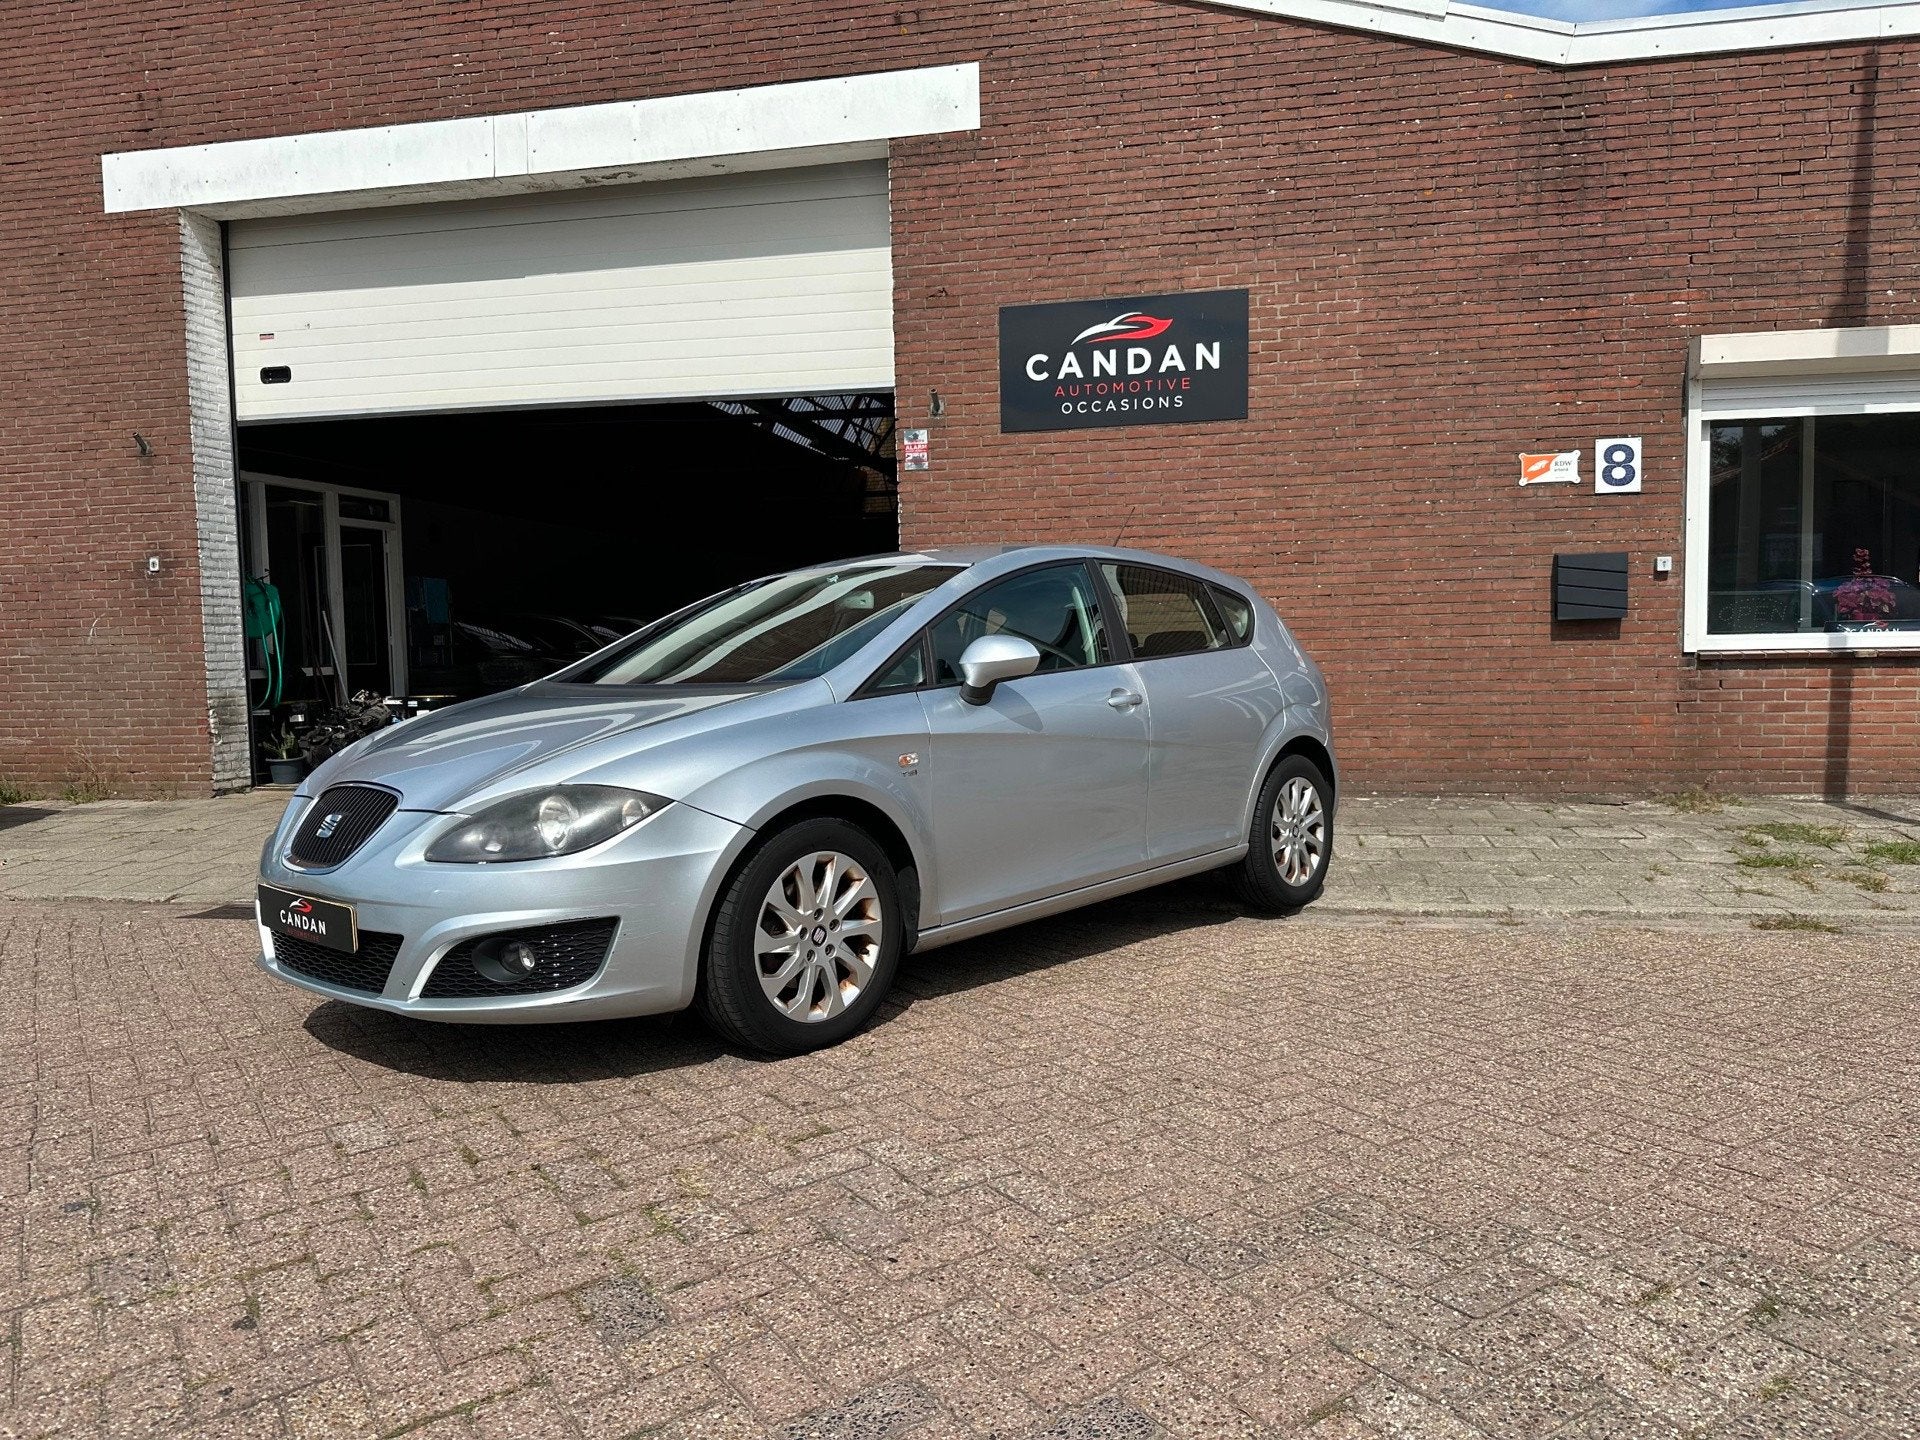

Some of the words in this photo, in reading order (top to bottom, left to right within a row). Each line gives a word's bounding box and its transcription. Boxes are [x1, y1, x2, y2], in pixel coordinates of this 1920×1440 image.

[1026, 342, 1220, 381] CANDAN
[1055, 378, 1191, 397] AUTOMOTIVE
[1061, 396, 1183, 414] OCCASIONS
[1602, 444, 1636, 486] 8
[1719, 606, 1788, 622] OPEN
[280, 909, 327, 935] CANDAN
